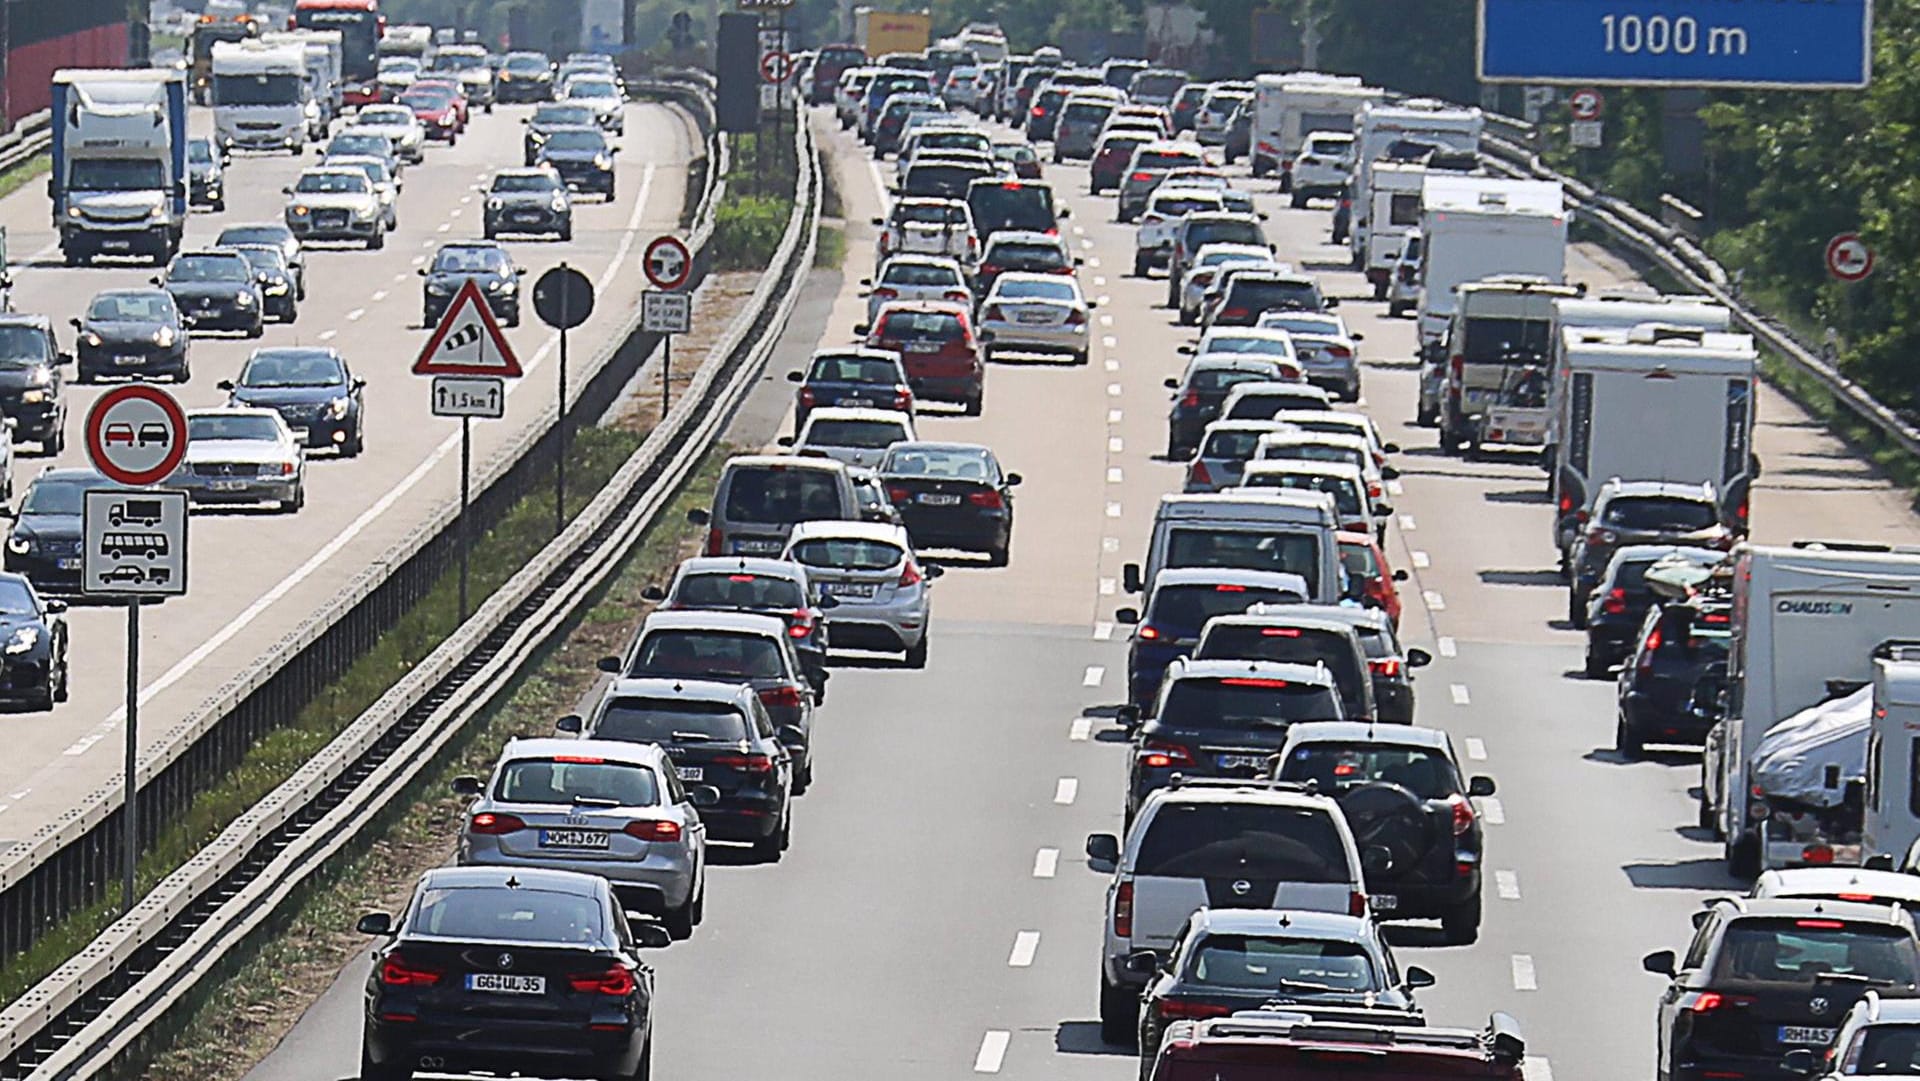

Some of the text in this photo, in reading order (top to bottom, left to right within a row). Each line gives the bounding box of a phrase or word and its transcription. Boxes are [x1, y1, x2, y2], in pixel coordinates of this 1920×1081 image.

[1601, 15, 1747, 55] 1000 m
[1776, 600, 1853, 615] CHAUSSON
